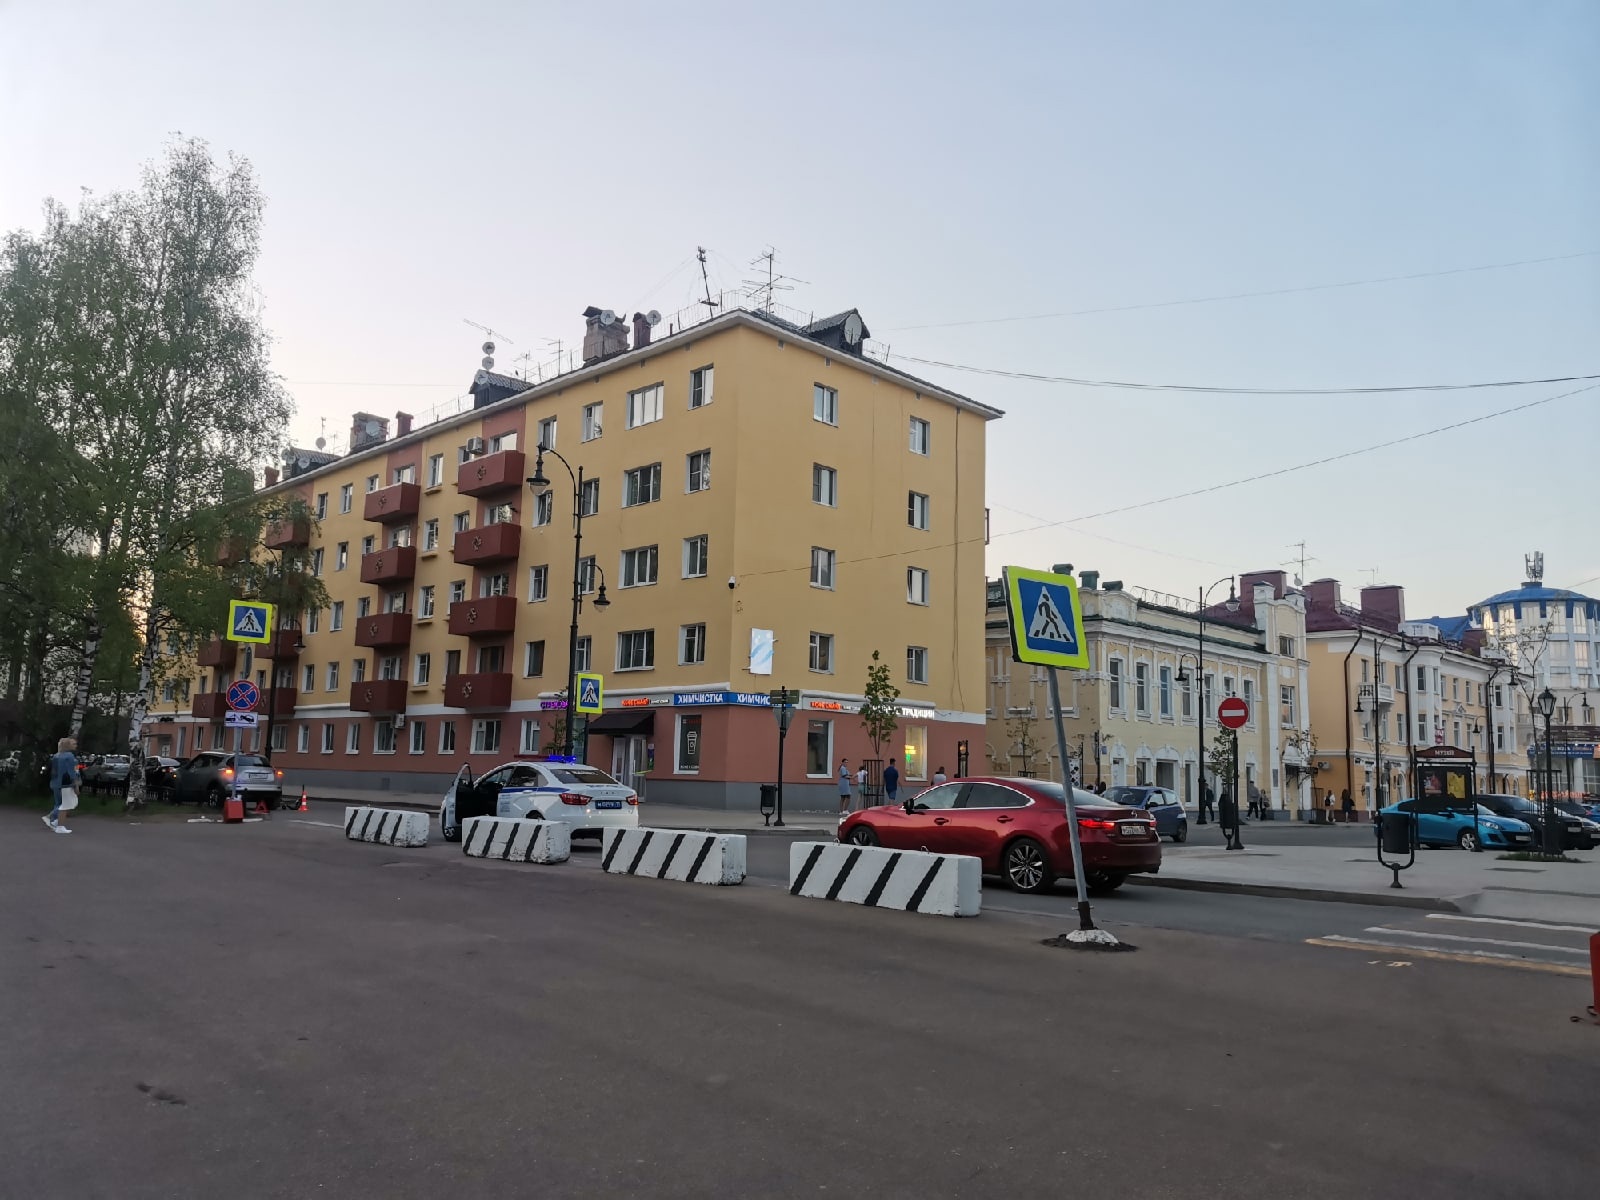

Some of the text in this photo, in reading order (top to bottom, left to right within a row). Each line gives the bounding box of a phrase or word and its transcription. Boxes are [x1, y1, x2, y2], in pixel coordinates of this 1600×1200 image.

[678, 693, 723, 704] ХИМЧИСТКА
[737, 693, 778, 705] ХИМЧИС
[902, 707, 935, 719] ТРАДИЦИИ
